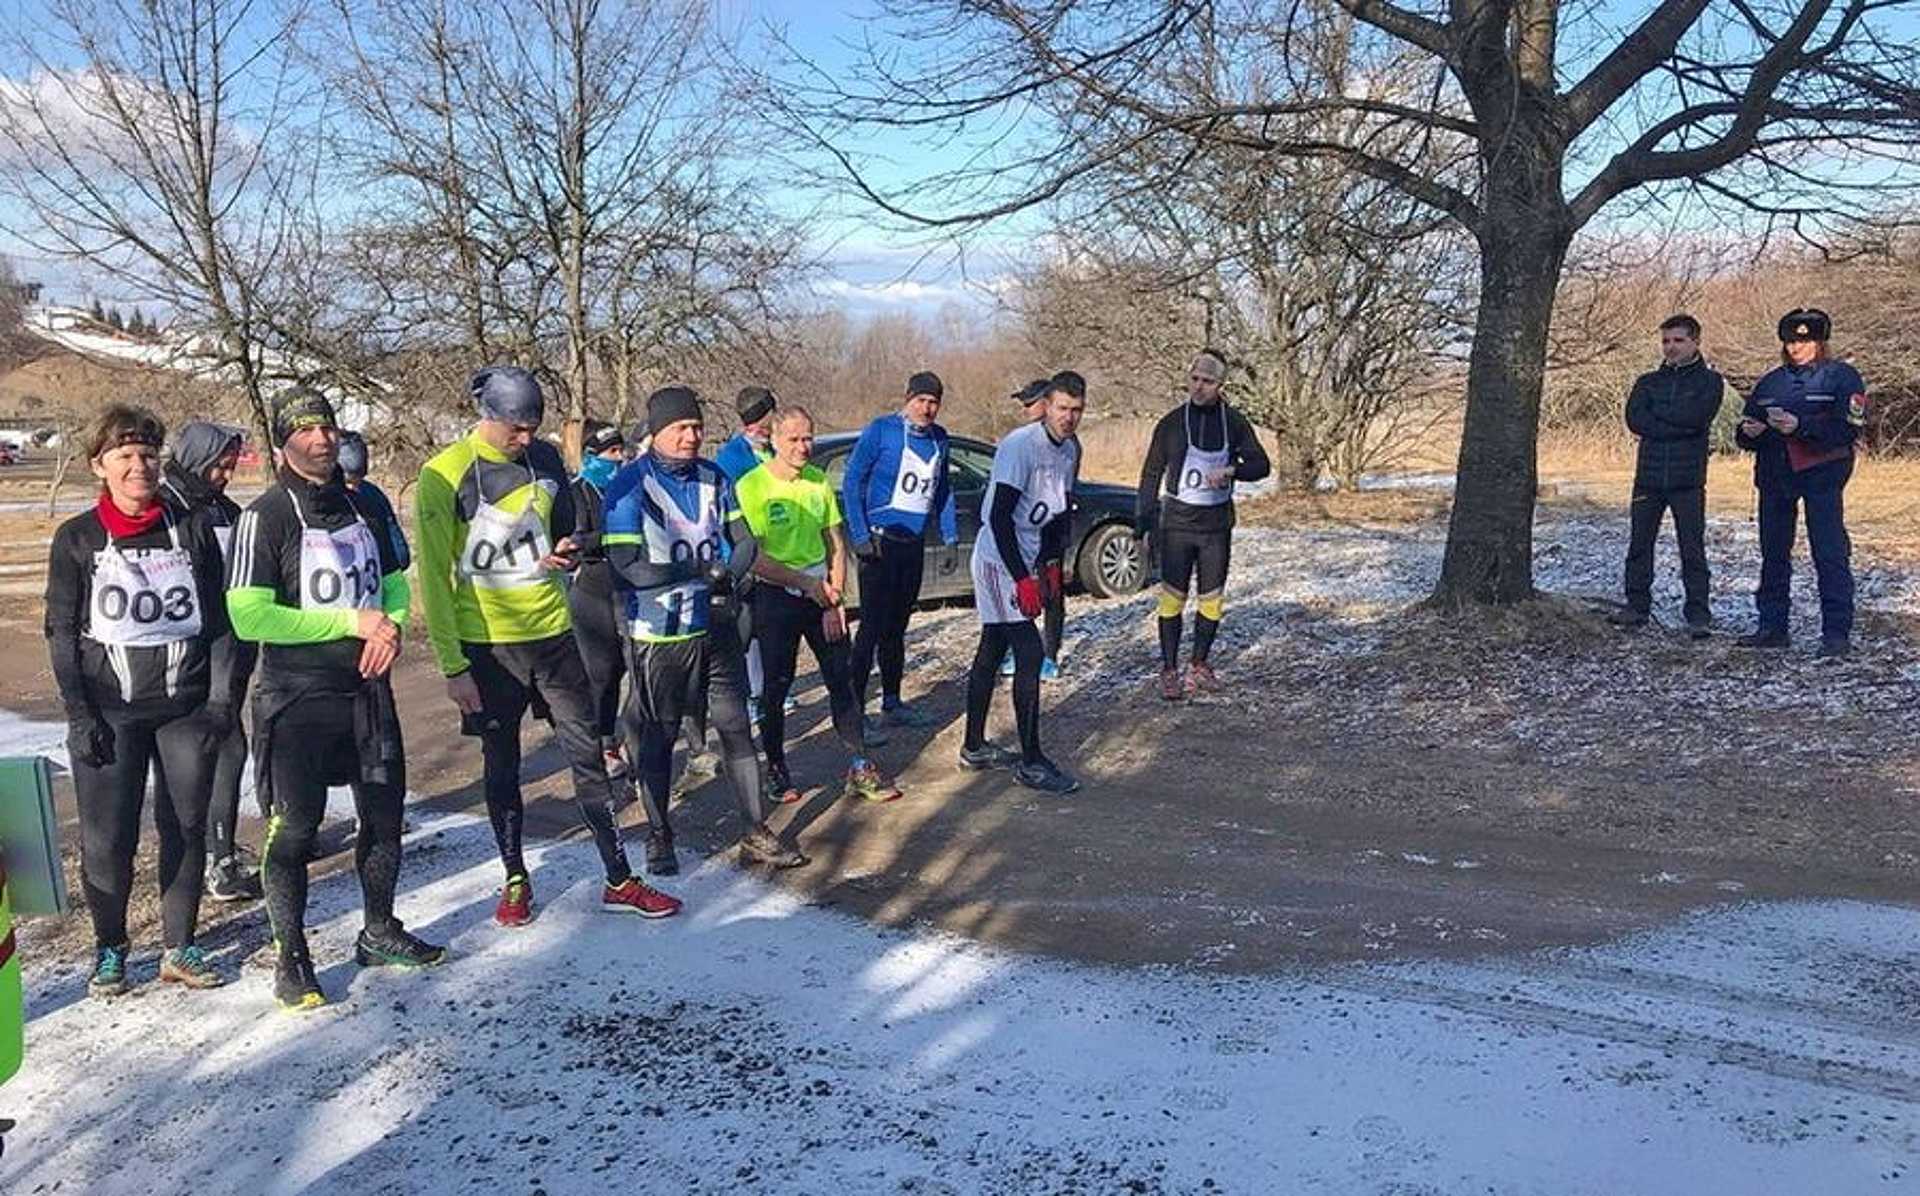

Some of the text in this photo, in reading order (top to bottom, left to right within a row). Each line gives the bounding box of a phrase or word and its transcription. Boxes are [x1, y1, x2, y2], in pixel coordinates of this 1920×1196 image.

[471, 530, 541, 570] 011
[309, 558, 380, 605] 013
[98, 585, 194, 623] 003
